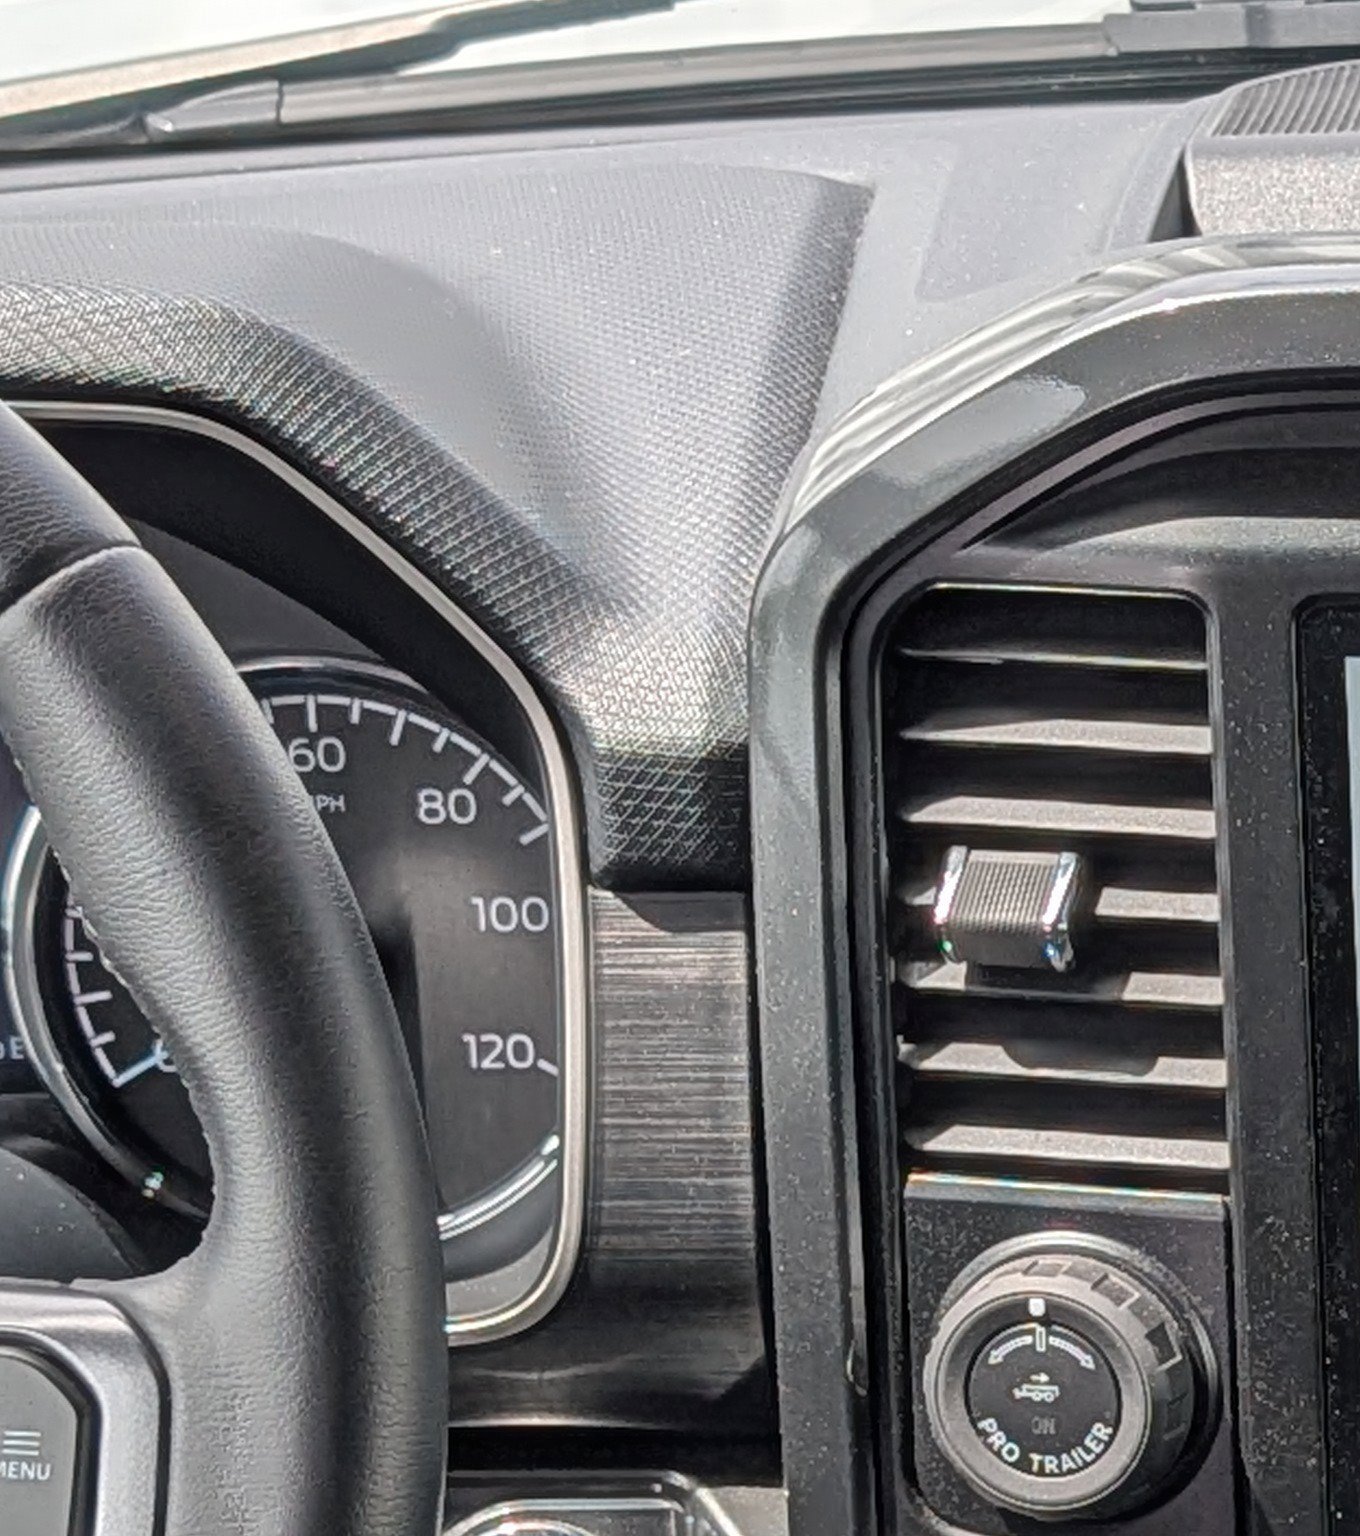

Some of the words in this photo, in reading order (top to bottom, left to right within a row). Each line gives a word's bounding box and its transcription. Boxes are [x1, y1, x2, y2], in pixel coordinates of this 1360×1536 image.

[288, 735, 347, 773] 60
[417, 787, 478, 825] 80
[470, 896, 550, 934] 100
[462, 1032, 536, 1071] 120
[1031, 1416, 1057, 1436] ON
[976, 1417, 1022, 1464] PRO
[1027, 1421, 1115, 1475] TRAILER
